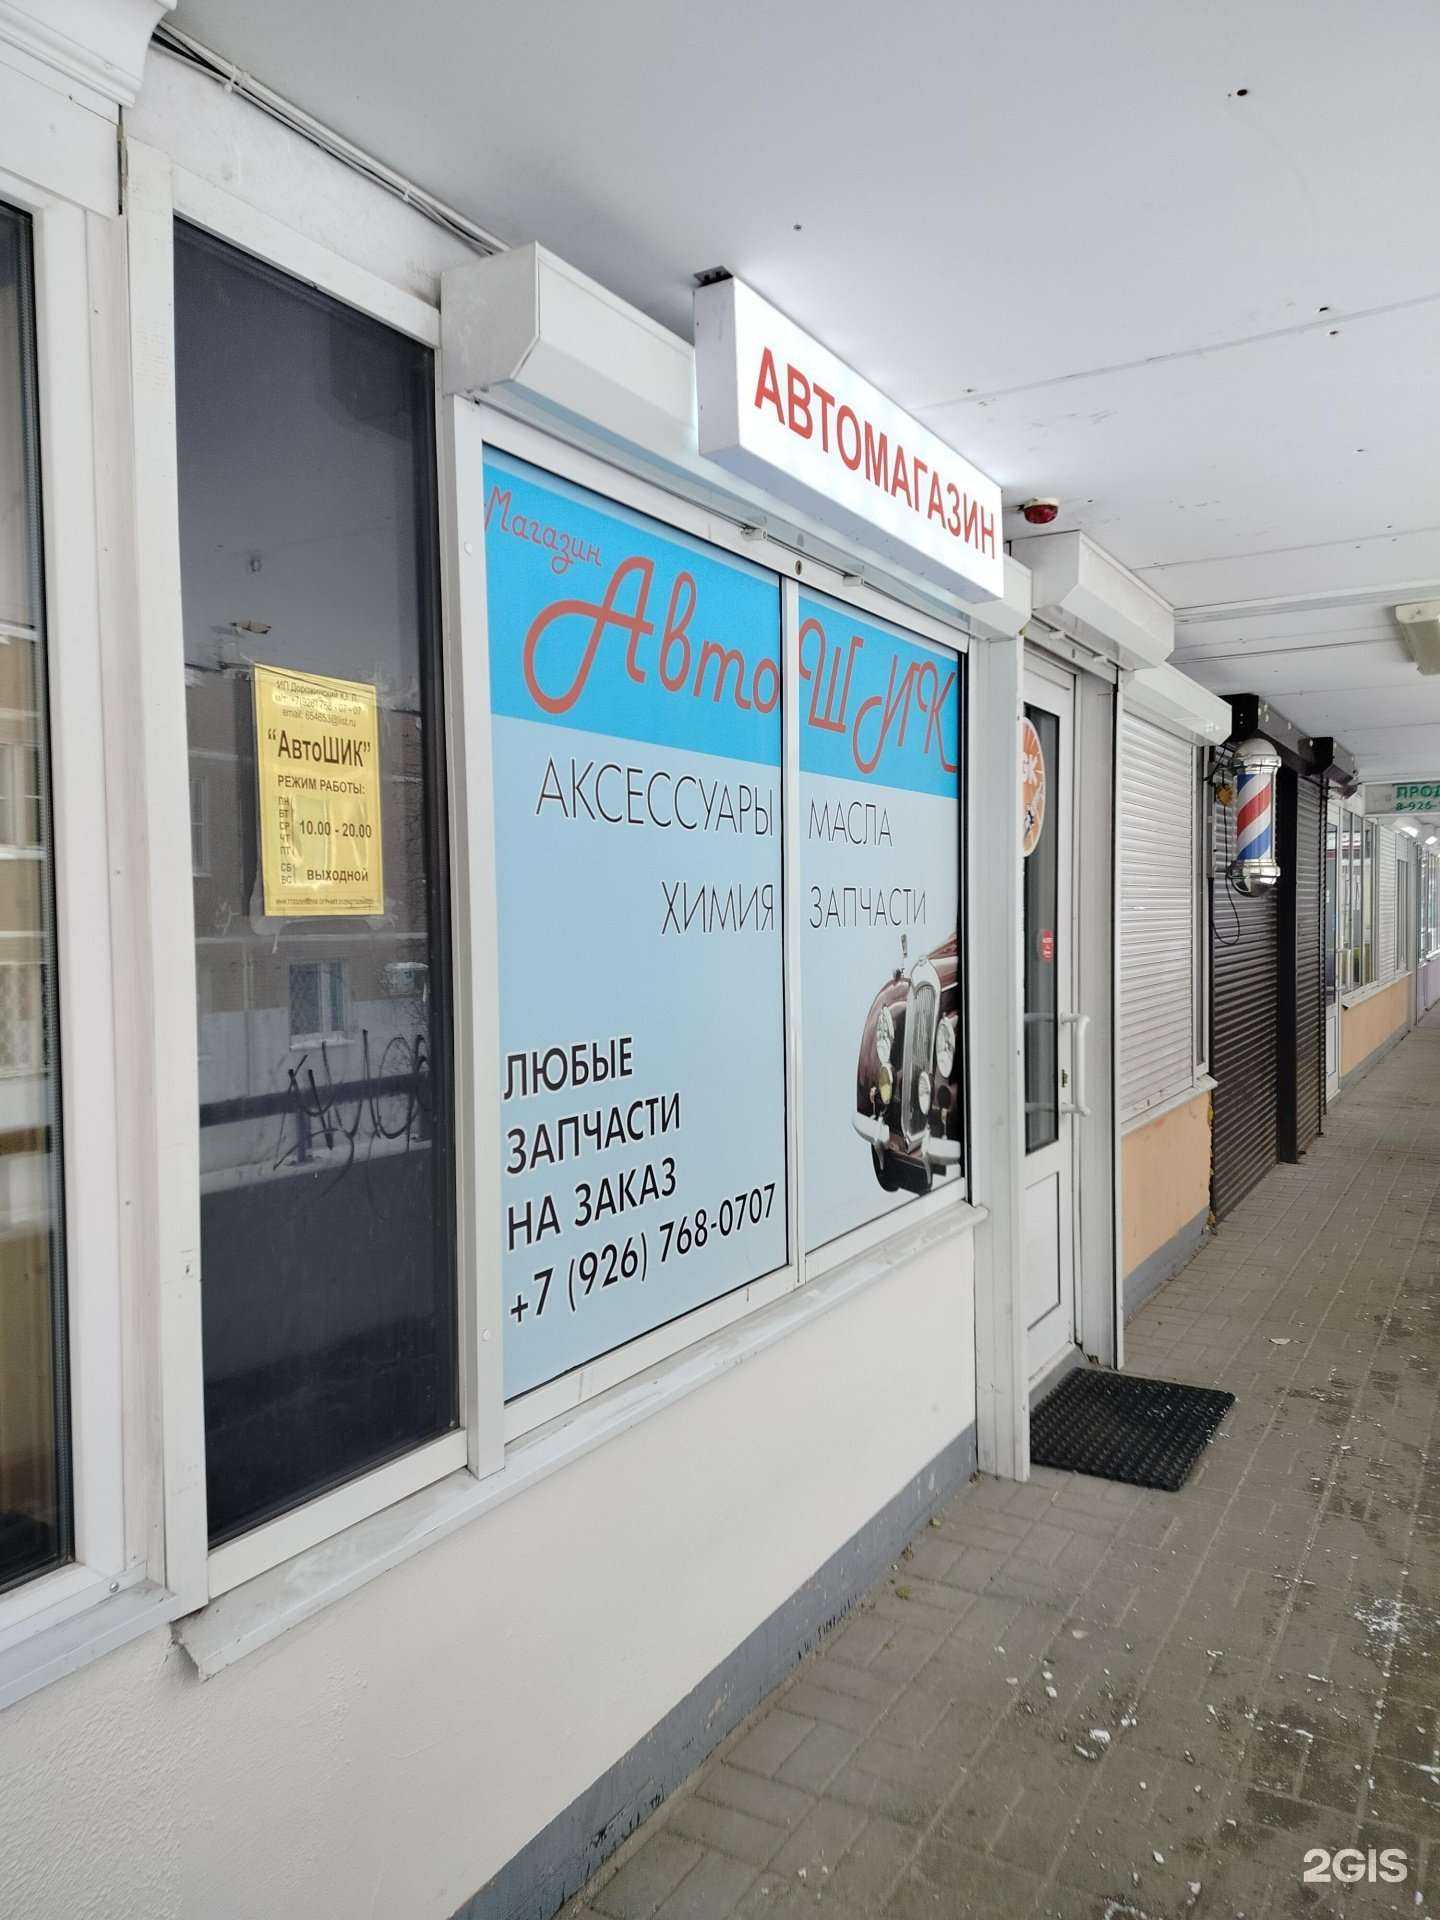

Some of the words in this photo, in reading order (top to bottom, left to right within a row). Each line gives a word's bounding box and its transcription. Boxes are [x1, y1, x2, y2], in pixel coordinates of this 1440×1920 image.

[754, 346, 995, 560] АВТОМАГАЗИН
[484, 485, 602, 575] Магазин
[278, 775, 317, 790] РЕЖИМ
[320, 780, 366, 795] РАБОТЫ:
[535, 756, 774, 837] АКСЕССУАРЫ
[299, 820, 331, 836] 10.00
[342, 823, 372, 838] 20.00
[809, 800, 893, 847] МАСЛА
[661, 881, 774, 935] ХИМИЯ
[809, 886, 926, 930] ЗАПЧАСТИ
[503, 1037, 633, 1100] ЛЮБЫЕ
[506, 1092, 680, 1174] ЗАПЧАСТИ
[508, 1195, 561, 1251] НА
[574, 1157, 676, 1227] ЗАКАЗ
[510, 1268, 554, 1323] +7
[568, 1231, 648, 1312] (926)
[659, 1183, 776, 1262] 768-0707
